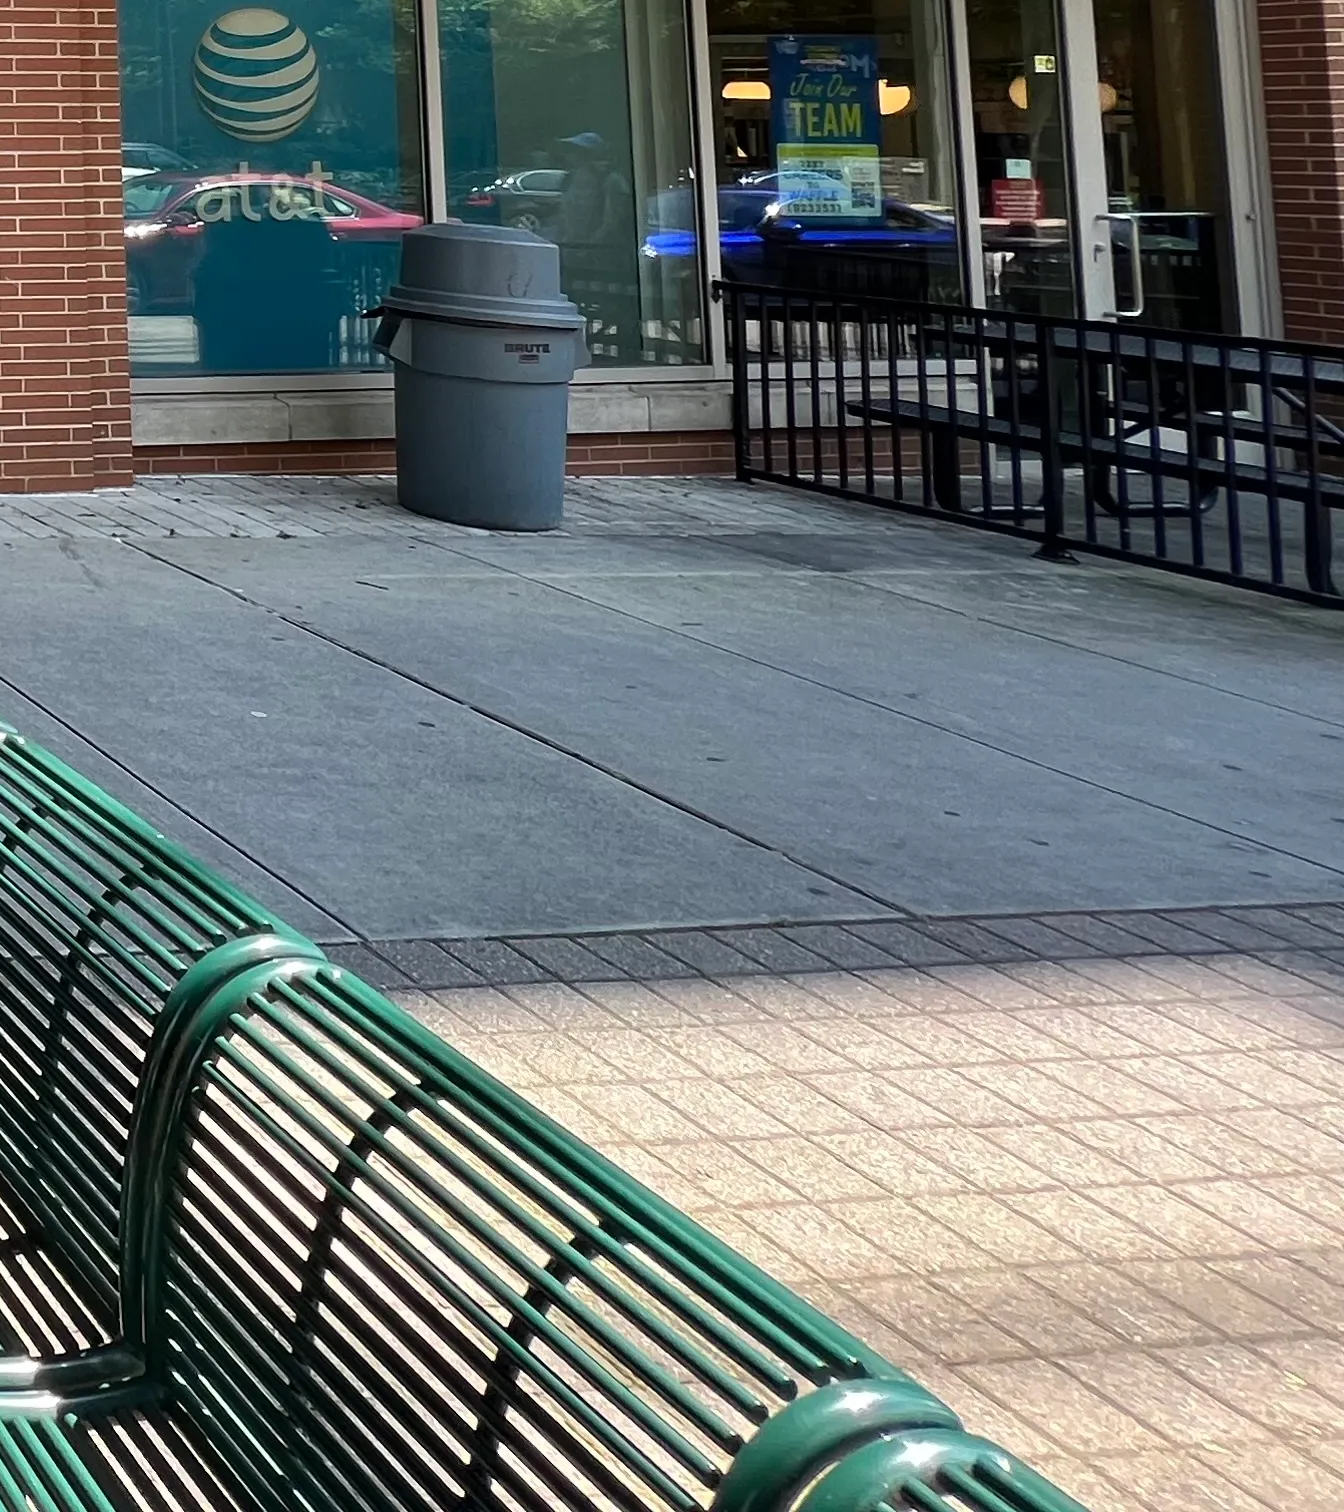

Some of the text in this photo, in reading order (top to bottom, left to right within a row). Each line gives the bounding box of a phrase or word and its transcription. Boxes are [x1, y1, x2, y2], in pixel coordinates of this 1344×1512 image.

[790, 73, 824, 96] Join
[788, 102, 862, 137] TEAM
[196, 160, 335, 223] at&t
[504, 343, 551, 354] BRUTE
